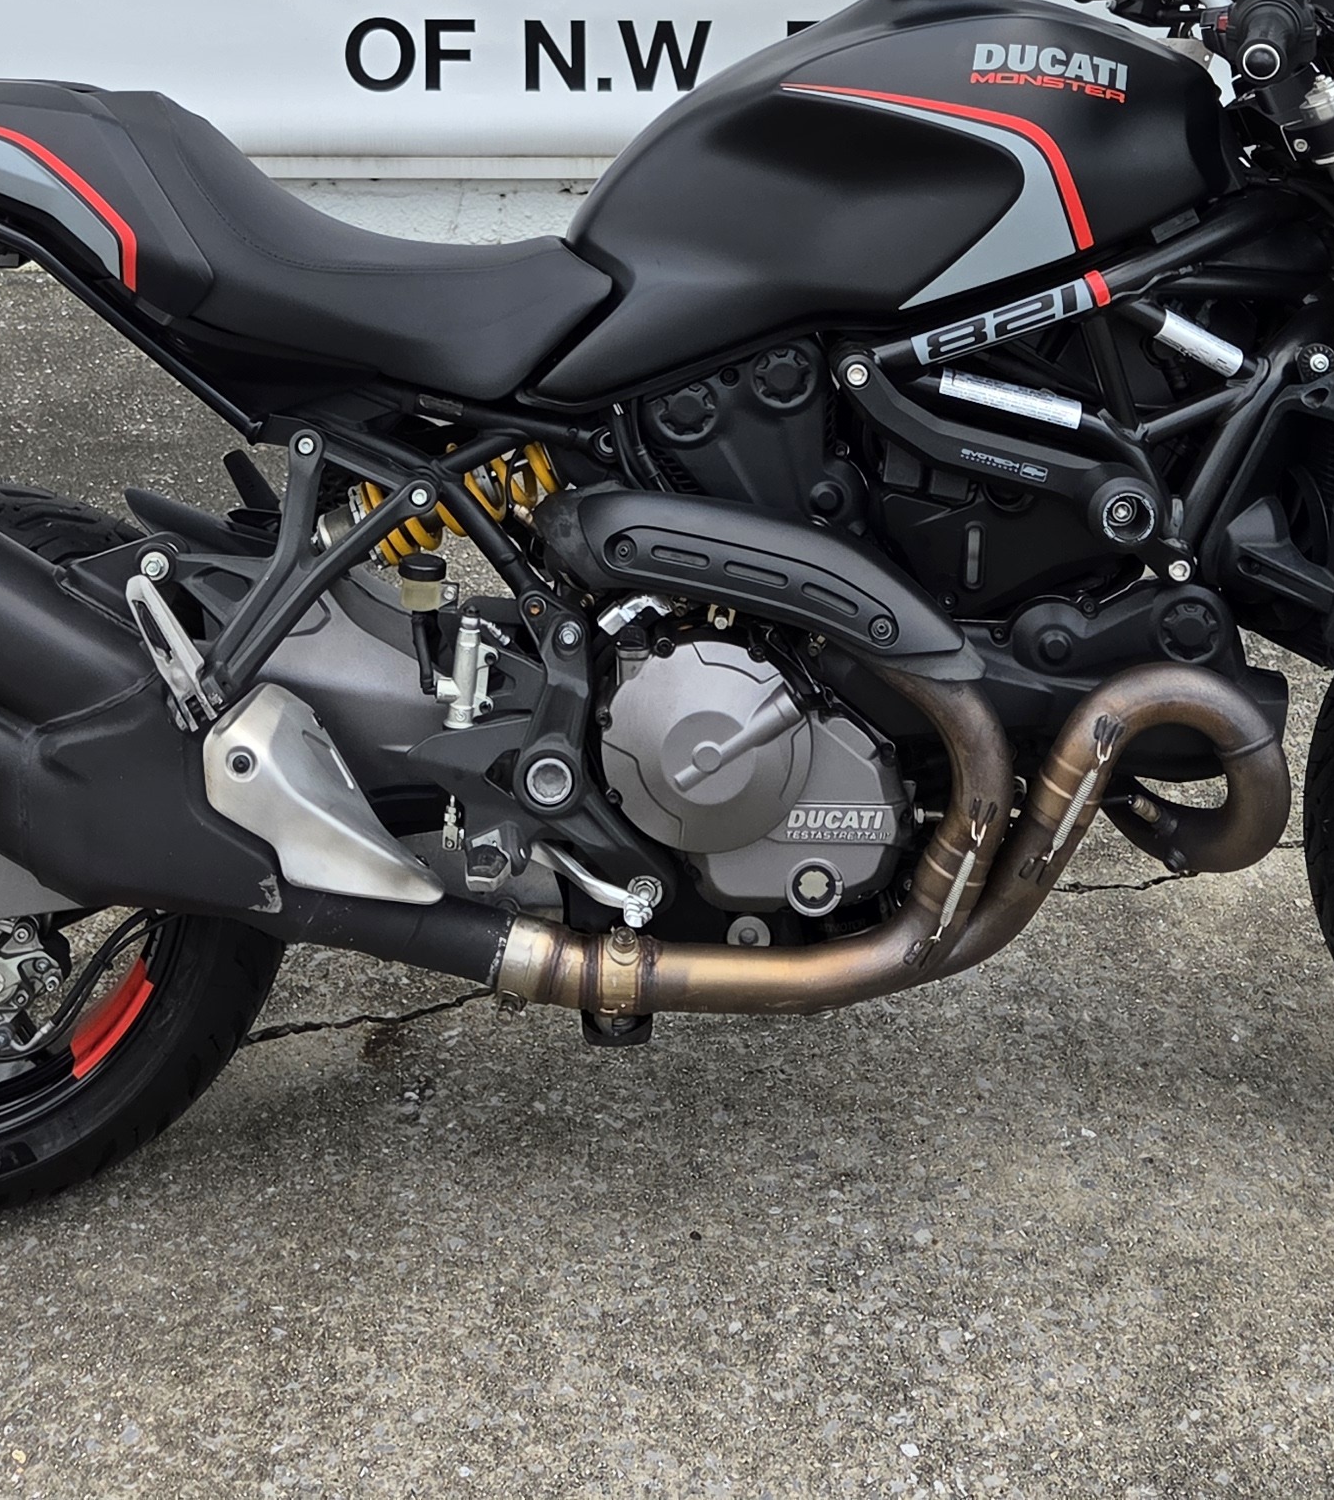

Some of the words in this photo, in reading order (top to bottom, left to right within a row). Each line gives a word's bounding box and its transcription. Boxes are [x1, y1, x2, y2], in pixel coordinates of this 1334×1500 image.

[344, 16, 476, 92] OF
[972, 43, 1128, 91] DUCATI
[970, 71, 1126, 104] MONSTER
[926, 284, 1078, 360] 821
[786, 830, 876, 840] TESTASTRETTA
[787, 809, 884, 829] DUCATI
